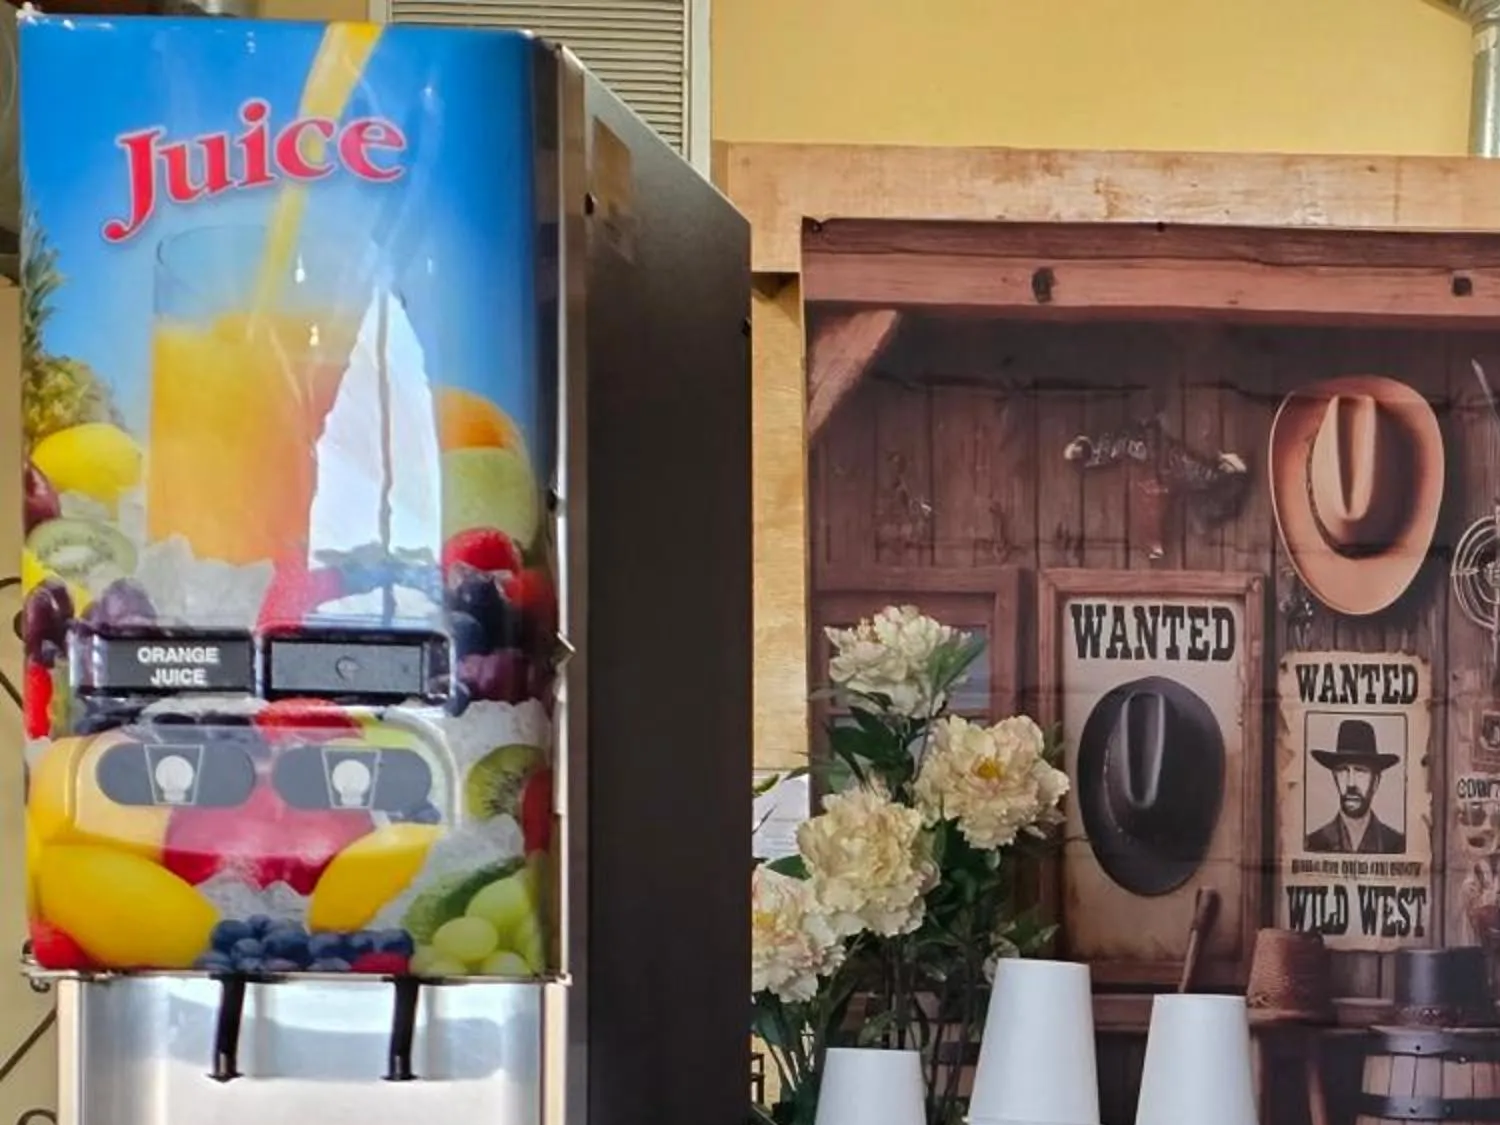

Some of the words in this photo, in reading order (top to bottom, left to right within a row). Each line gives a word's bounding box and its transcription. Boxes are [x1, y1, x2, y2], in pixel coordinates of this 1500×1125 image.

[104, 99, 408, 243] Juice
[137, 647, 219, 663] ORANGE
[1071, 603, 1235, 662] WANTED
[151, 668, 207, 686] JUICE
[1296, 662, 1419, 705] WANTED
[1286, 884, 1349, 935] WILD
[1357, 885, 1426, 937] WEST
